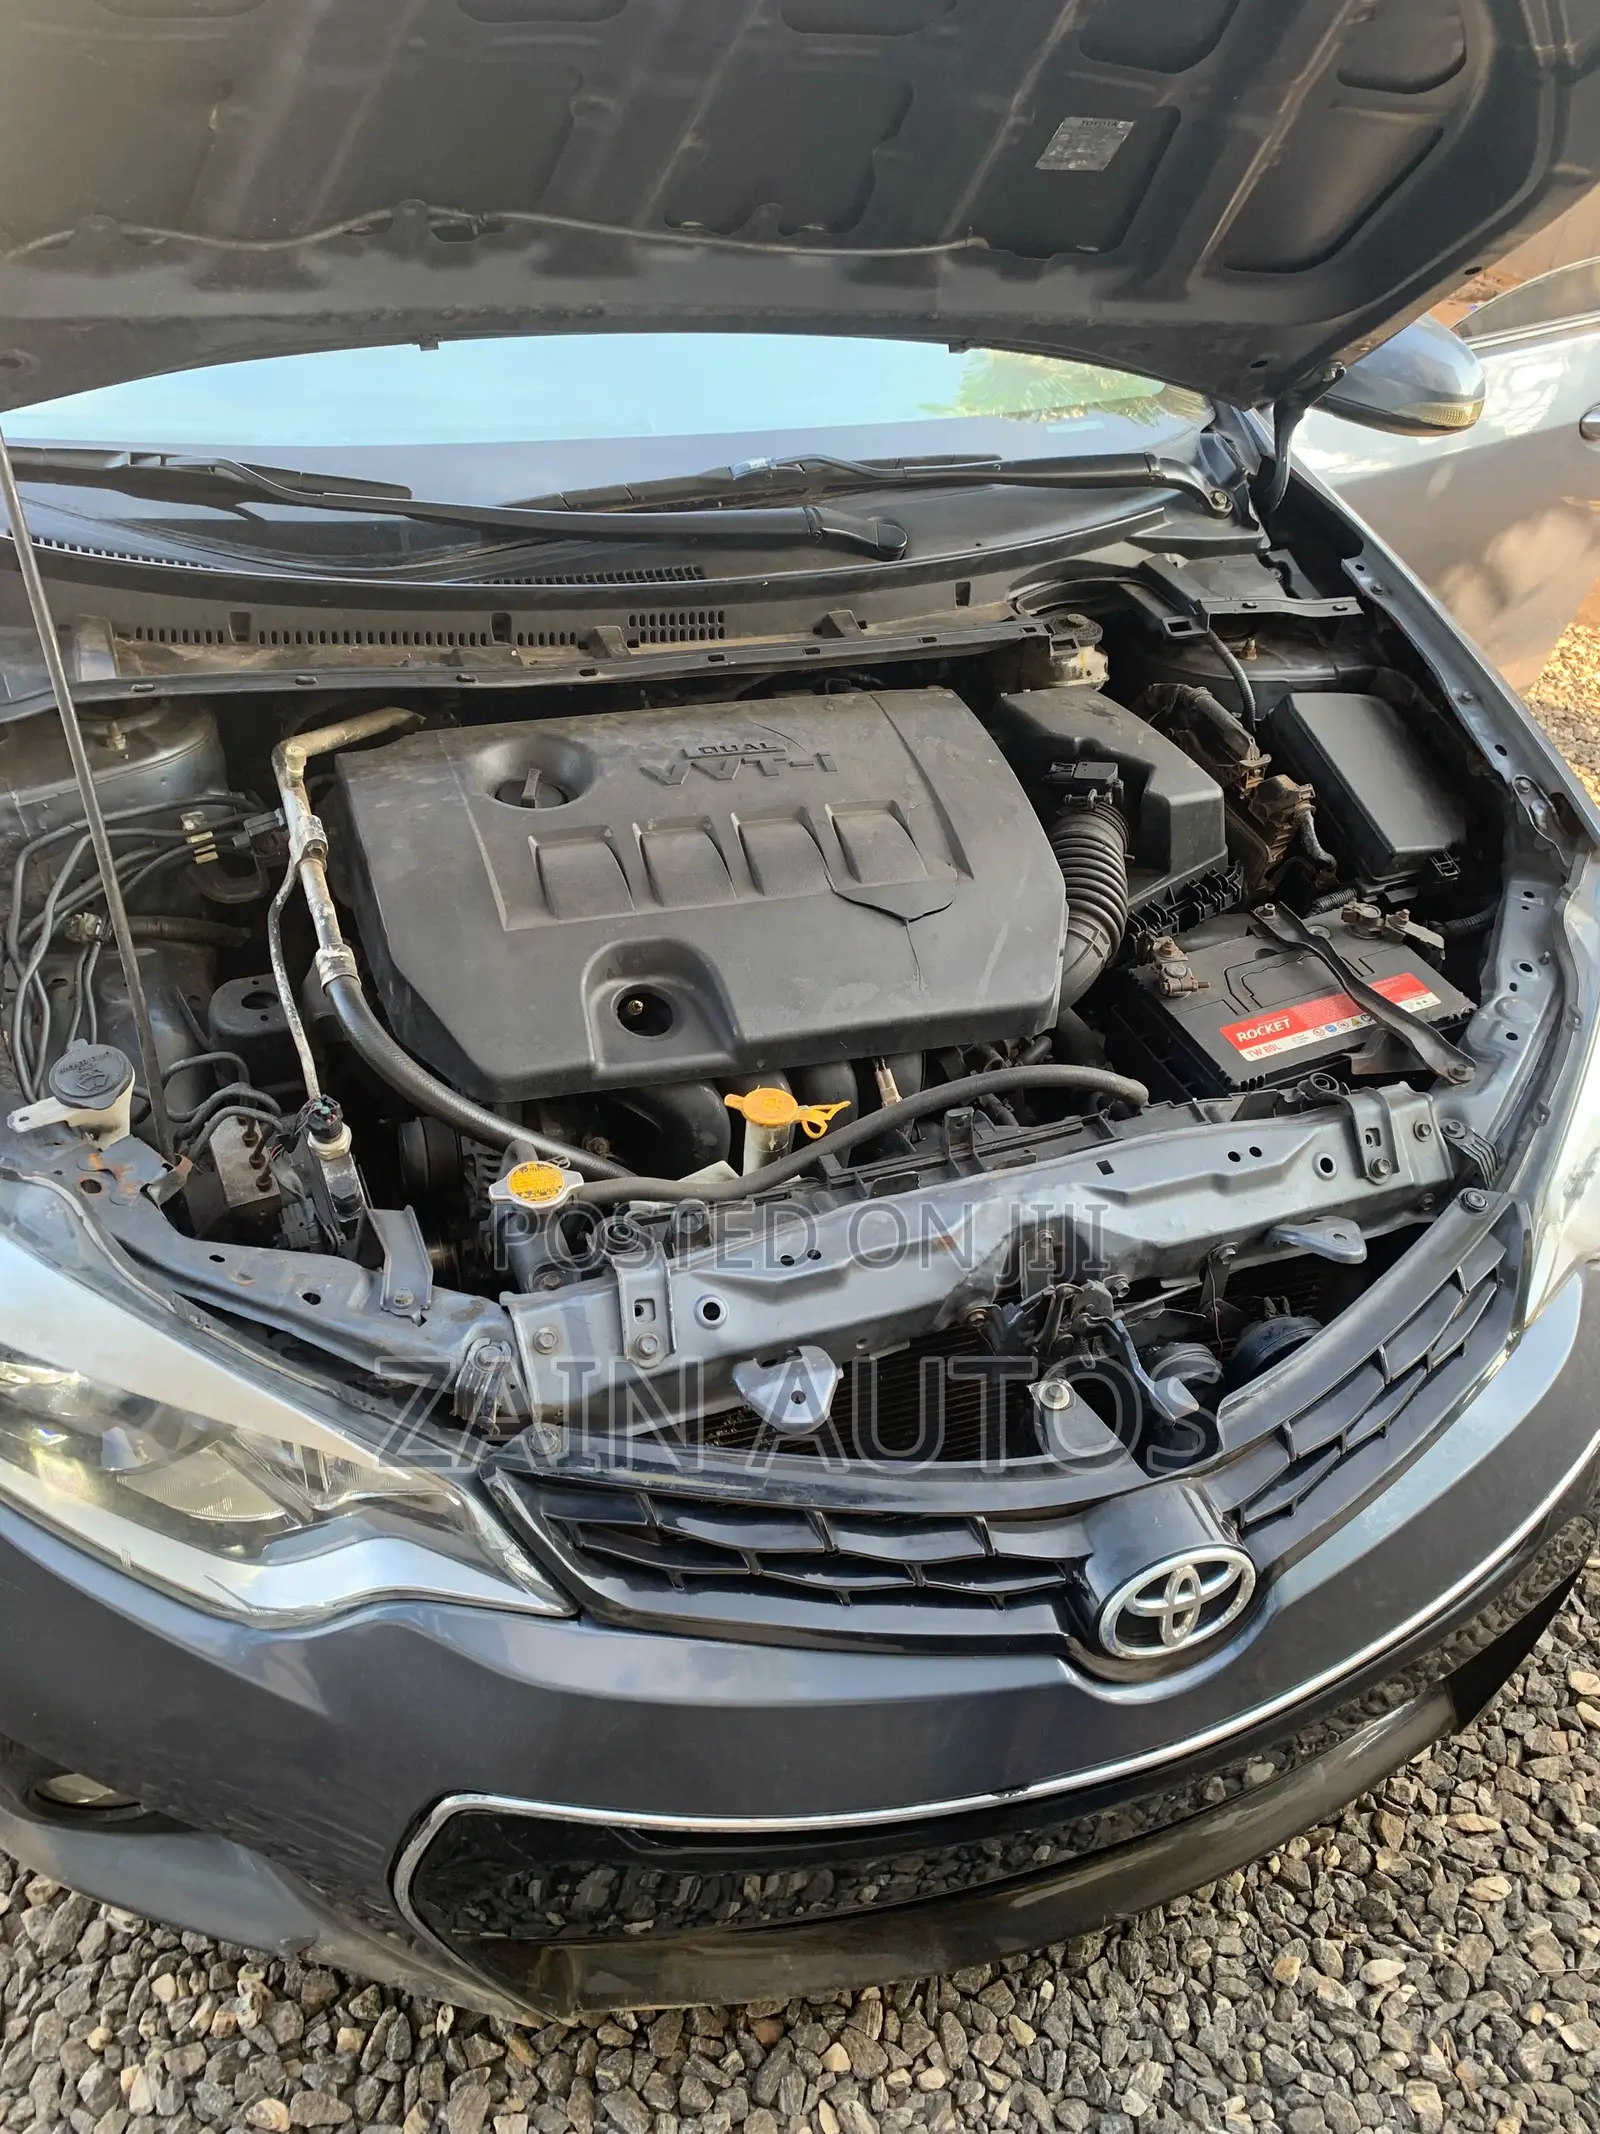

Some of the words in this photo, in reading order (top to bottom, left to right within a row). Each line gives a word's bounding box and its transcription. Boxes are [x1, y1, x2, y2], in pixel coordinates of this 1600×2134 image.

[1081, 120, 1118, 128] TOYOTA
[698, 742, 778, 755] DUAL
[1236, 1018, 1292, 1043] ROCKET
[1246, 1048, 1263, 1058] TW
